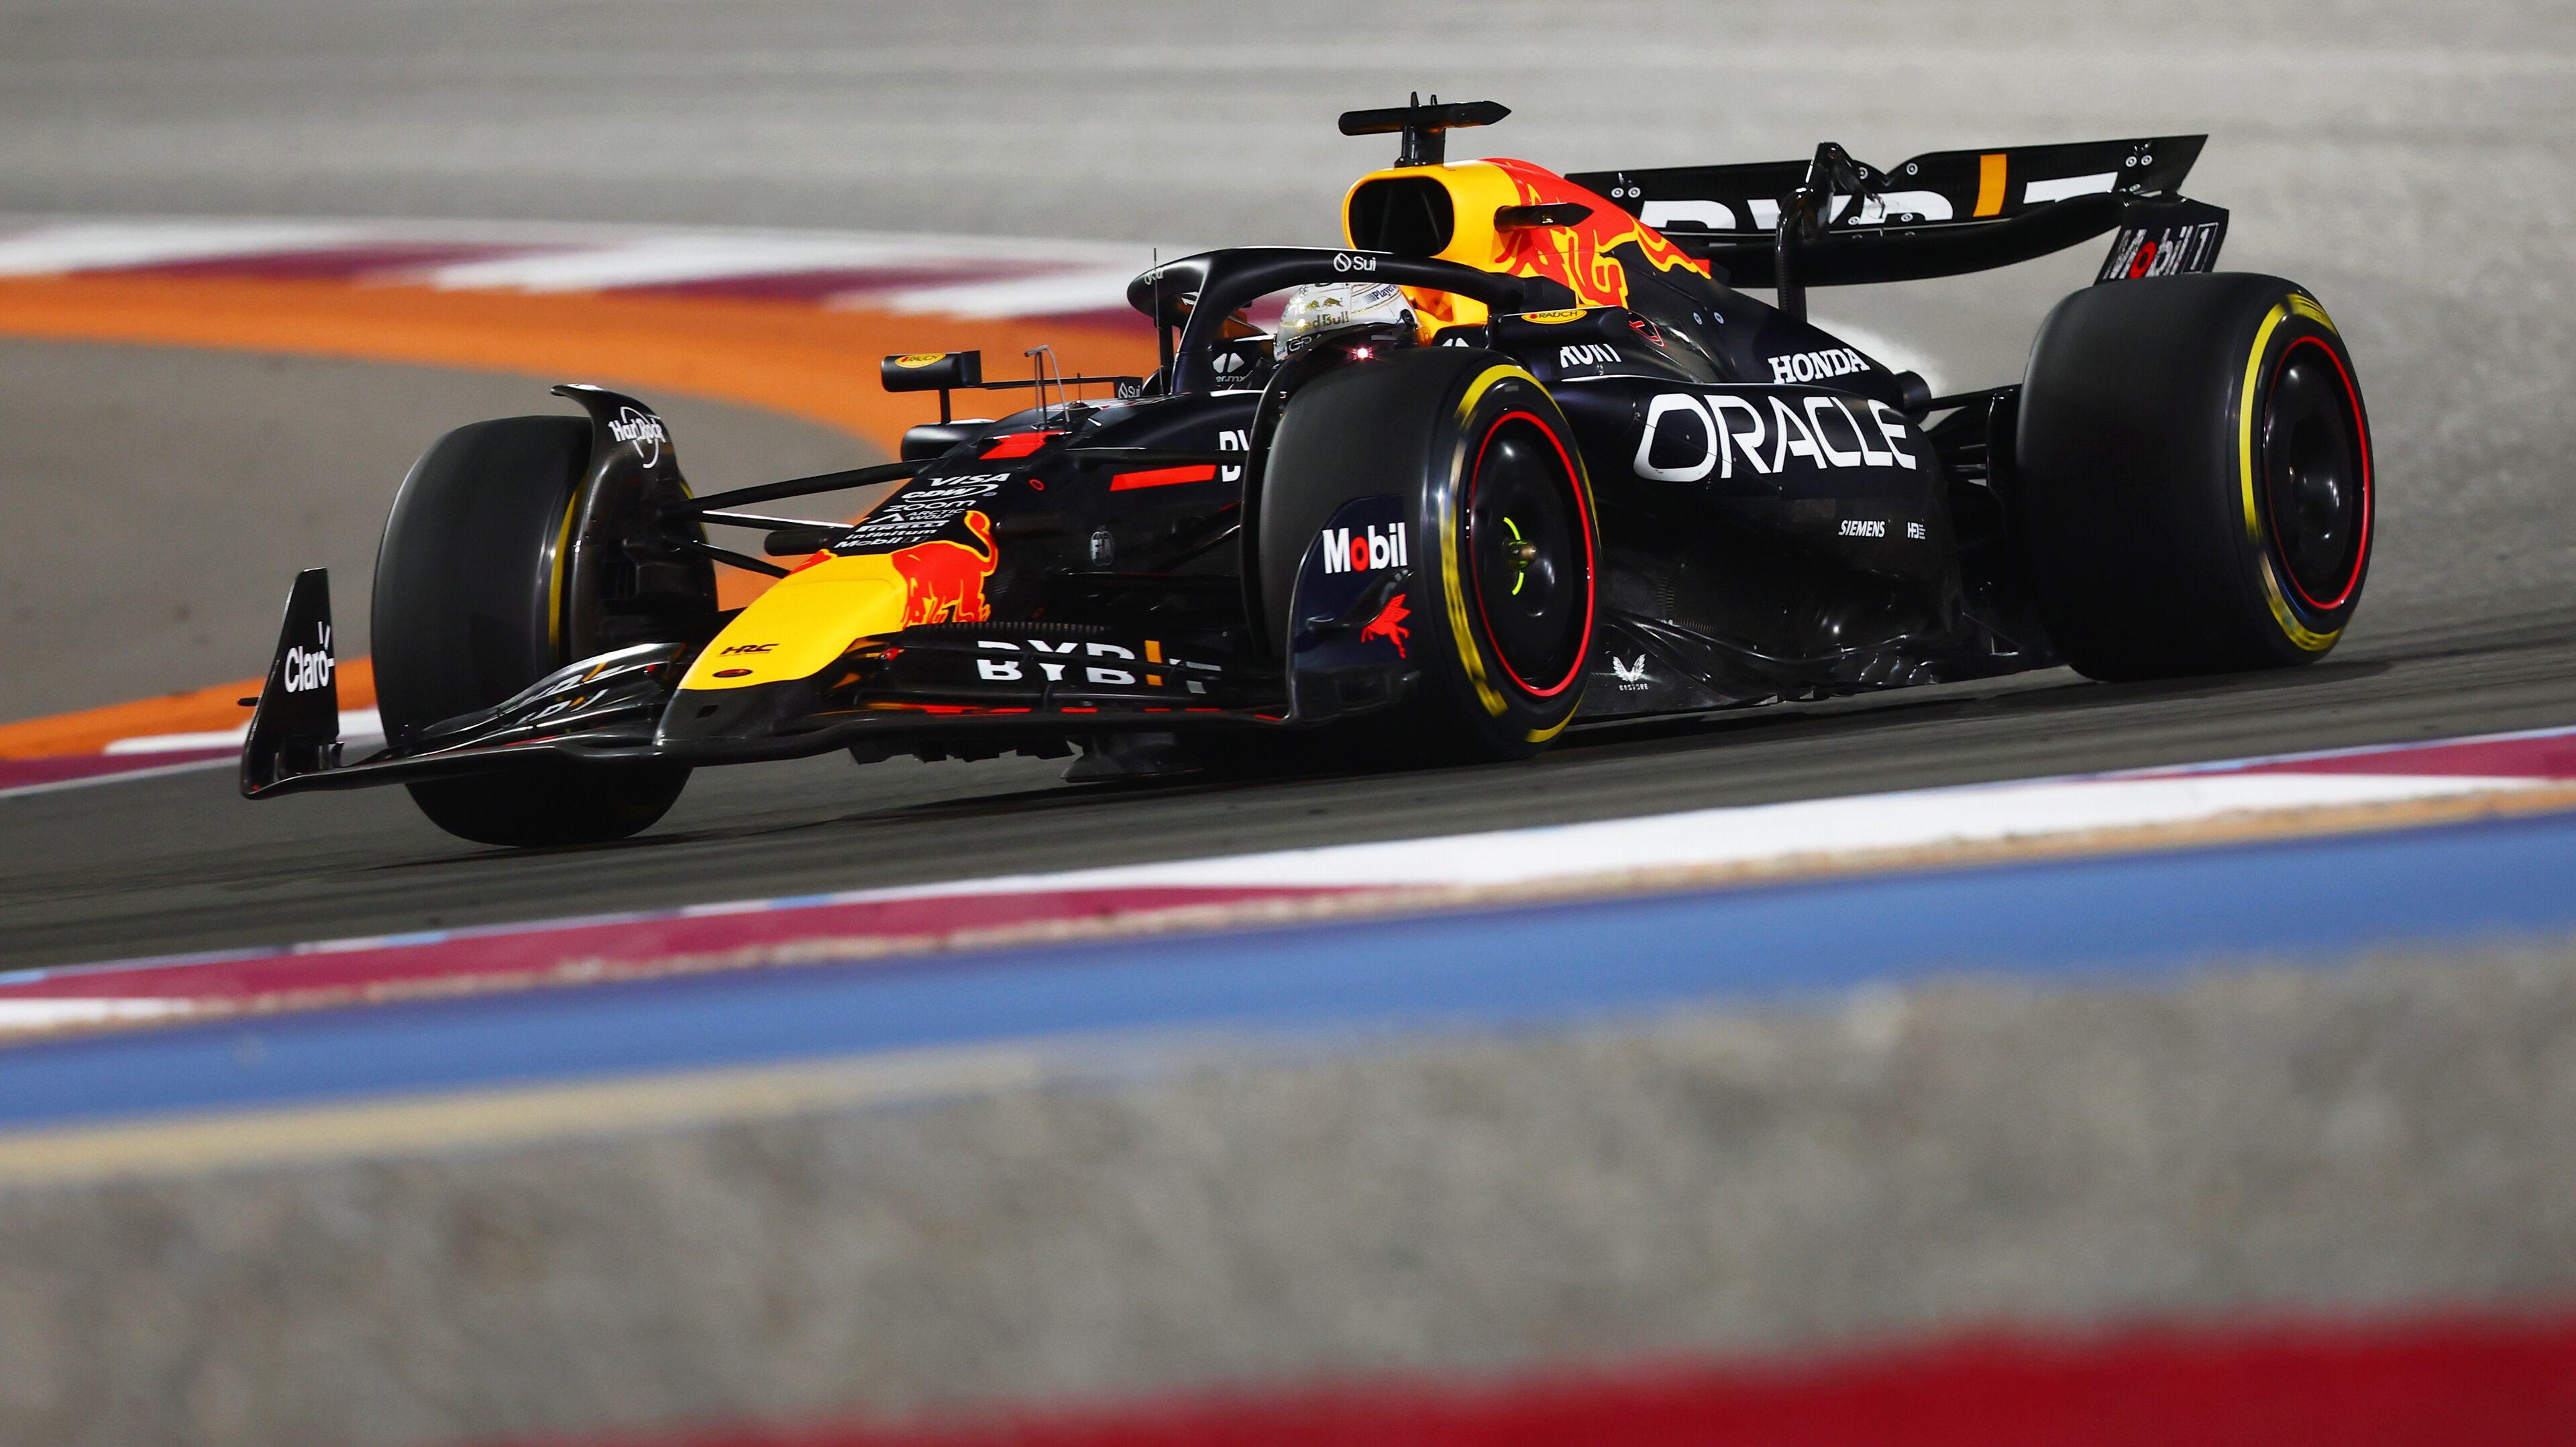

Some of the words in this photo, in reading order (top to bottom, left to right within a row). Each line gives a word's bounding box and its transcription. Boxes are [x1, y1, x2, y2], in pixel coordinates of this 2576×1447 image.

[2102, 225, 2194, 279] Mobil
[2190, 228, 2210, 270] 1
[1353, 256, 1377, 271] Sui
[1322, 311, 1348, 326] Bull
[1539, 311, 1578, 319] RAUCH
[1768, 347, 1870, 384] HONDA
[1128, 385, 1140, 398] Sui
[1633, 393, 1916, 482] ORACLE
[928, 473, 1011, 486] VISA
[901, 486, 981, 499] CDW
[854, 520, 951, 533] PIRELLI
[1838, 520, 1886, 537] SIEMENS
[833, 537, 903, 548] Mobil
[1322, 522, 1408, 574] Mobil
[719, 643, 780, 655] HRC
[284, 645, 330, 693] Claro
